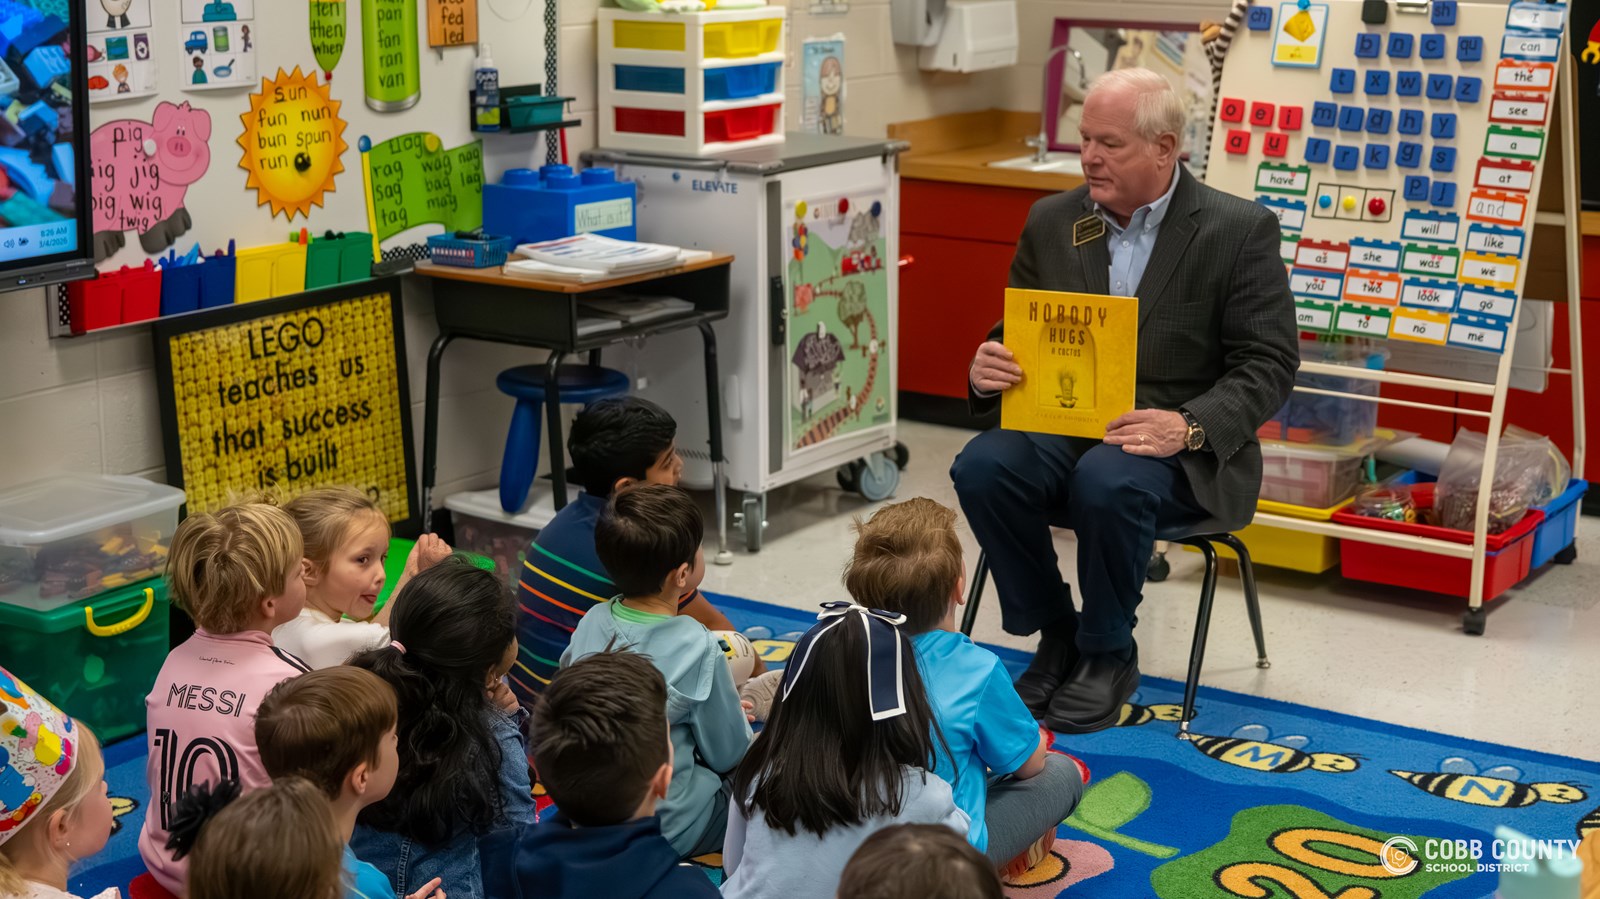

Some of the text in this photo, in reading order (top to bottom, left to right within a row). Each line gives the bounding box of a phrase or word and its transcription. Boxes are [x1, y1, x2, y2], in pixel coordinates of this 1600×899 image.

[377, 8, 402, 28] pan
[442, 7, 464, 25] fed
[1250, 9, 1269, 23] ch
[1434, 5, 1450, 17] sh
[310, 21, 343, 38] then
[444, 28, 464, 44] led
[377, 30, 400, 49] fan
[1361, 36, 1477, 55] b n c qu
[1520, 42, 1541, 52] can
[312, 41, 343, 55] when
[379, 52, 403, 68] ran
[379, 72, 405, 88] van
[1338, 71, 1472, 95] t x w v z
[1514, 71, 1533, 82] the
[258, 105, 332, 127] fun nun
[1225, 105, 1236, 117] o
[1255, 109, 1266, 121] e
[1508, 107, 1528, 116] see
[1314, 107, 1332, 119] m
[1404, 113, 1415, 128] h
[1439, 117, 1449, 133] y
[112, 121, 143, 158] pig
[258, 128, 332, 156] bun spun
[1231, 135, 1279, 149] a u
[1510, 142, 1517, 151] a
[259, 153, 289, 171] run
[1342, 150, 1350, 163] r
[1371, 147, 1382, 163] k
[1402, 144, 1415, 162] g
[1436, 151, 1446, 164] s
[91, 154, 160, 192] ig jig
[373, 148, 481, 182] rag wag nag
[692, 180, 738, 194] ELEVATE
[1270, 174, 1295, 186] have
[1410, 178, 1422, 196] p
[1498, 174, 1512, 184] at
[376, 172, 482, 205] sag bag lag
[130, 191, 162, 222] wig
[119, 209, 149, 232] twig
[381, 207, 408, 229] tag
[55, 226, 68, 235] AM
[1421, 224, 1440, 236] will
[1484, 236, 1504, 249] like
[1315, 255, 1328, 264] as
[1363, 252, 1382, 263] she
[1419, 258, 1440, 269] was
[1481, 268, 1496, 277] we
[1306, 281, 1325, 294] you
[1363, 283, 1382, 294] two
[1417, 291, 1440, 303] look
[1029, 301, 1108, 328] NOBODY
[1479, 301, 1494, 312] go
[1298, 314, 1313, 323] am
[1358, 318, 1369, 329] to
[1413, 323, 1426, 334] no
[248, 317, 325, 360] LEGO
[1049, 328, 1086, 346] HUGS
[1467, 333, 1484, 342] me
[218, 355, 364, 407] teaches us
[213, 400, 372, 457] that success
[259, 440, 339, 489] is built
[166, 682, 246, 718] MESSI
[1236, 745, 1285, 768] M
[153, 728, 239, 831] 10
[1458, 779, 1507, 801] N
